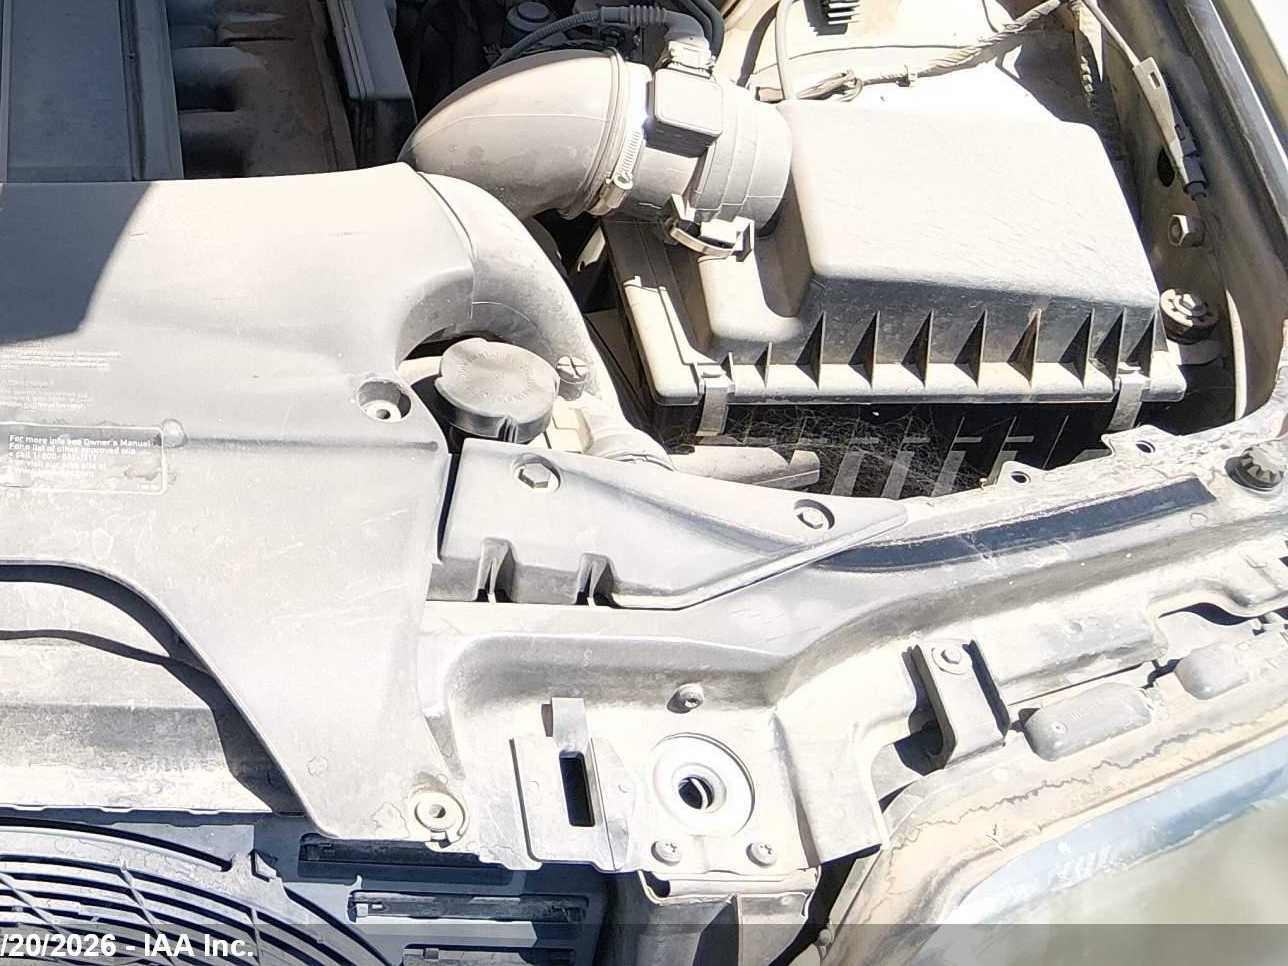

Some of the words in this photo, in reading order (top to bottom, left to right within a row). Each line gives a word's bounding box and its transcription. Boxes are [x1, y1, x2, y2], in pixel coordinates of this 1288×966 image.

[9, 434, 24, 443] For
[25, 436, 48, 444] more
[83, 438, 118, 446] Owner's
[120, 439, 151, 449] Manual
